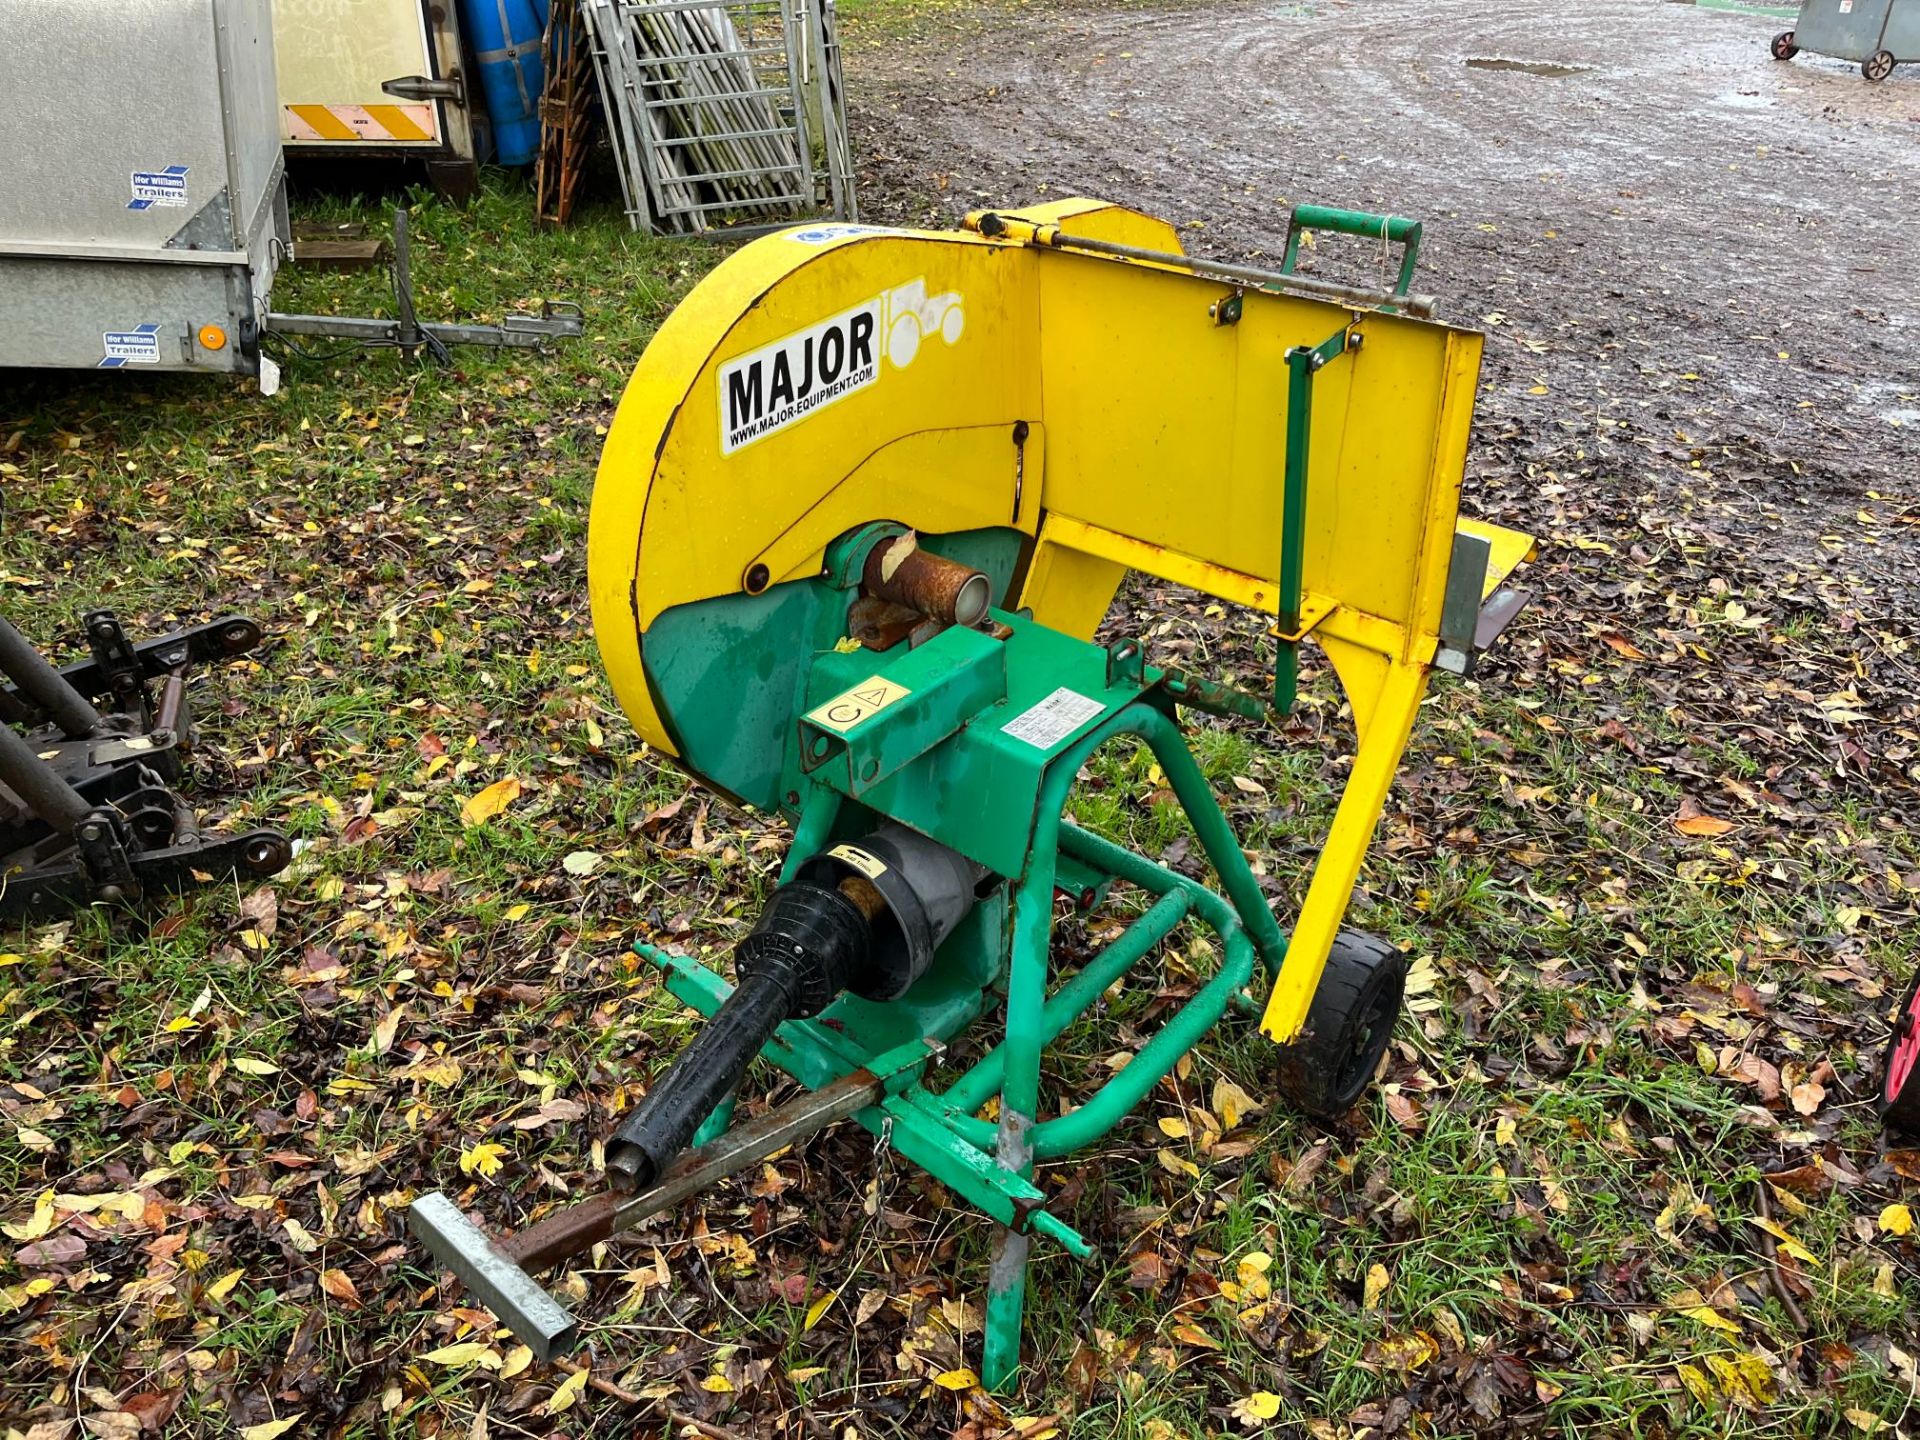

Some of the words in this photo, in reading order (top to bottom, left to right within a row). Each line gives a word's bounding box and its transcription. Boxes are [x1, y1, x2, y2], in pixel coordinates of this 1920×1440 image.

[150, 177, 184, 187] Williams
[136, 187, 184, 198] Trailers
[122, 336, 155, 345] Williams
[109, 346, 156, 355] Trailers
[728, 311, 874, 432] MAJOR
[729, 365, 874, 447] WWW.MAJOR-EQUIPMENT.COM
